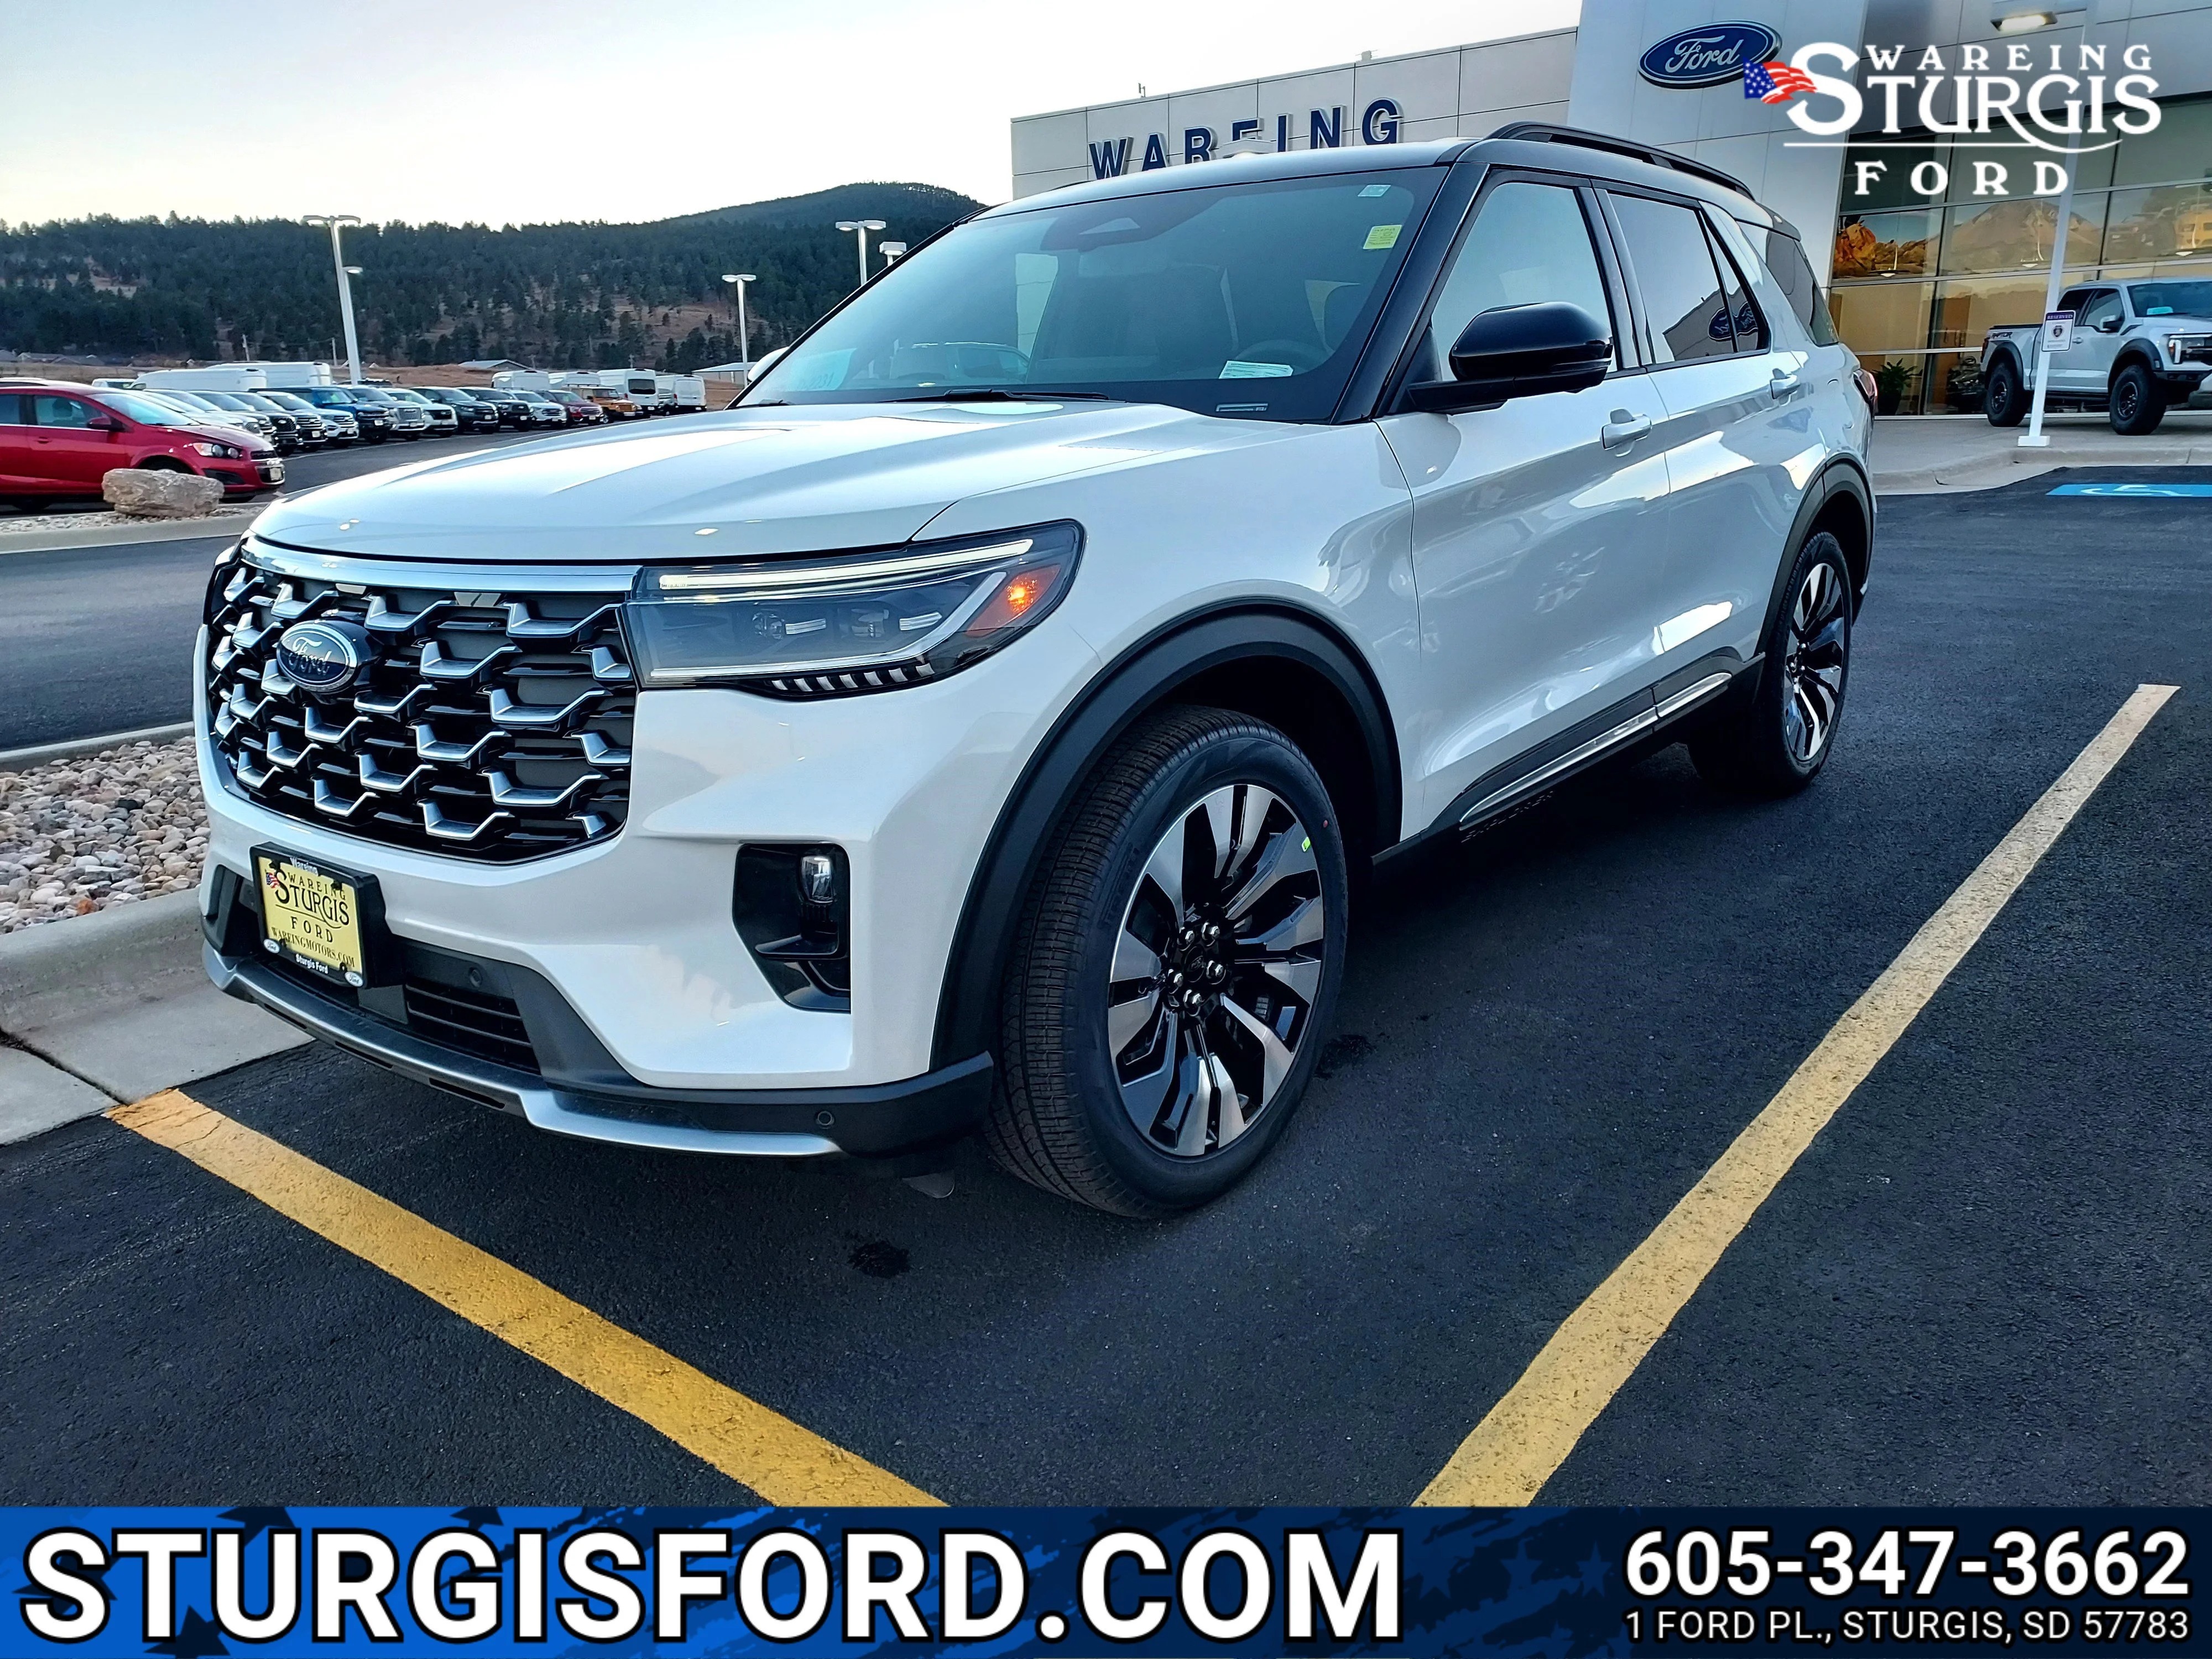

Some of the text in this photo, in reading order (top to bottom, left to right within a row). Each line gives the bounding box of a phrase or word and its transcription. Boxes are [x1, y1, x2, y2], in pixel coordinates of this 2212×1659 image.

[1665, 35, 1744, 73] Ford
[288, 637, 332, 676] Ford
[275, 869, 350, 928] STURGIS
[287, 872, 346, 901] WAREING
[271, 926, 355, 968] WAREINGMOTORS.COM
[290, 916, 333, 943] FORD
[295, 953, 329, 974] Sturgis Ford
